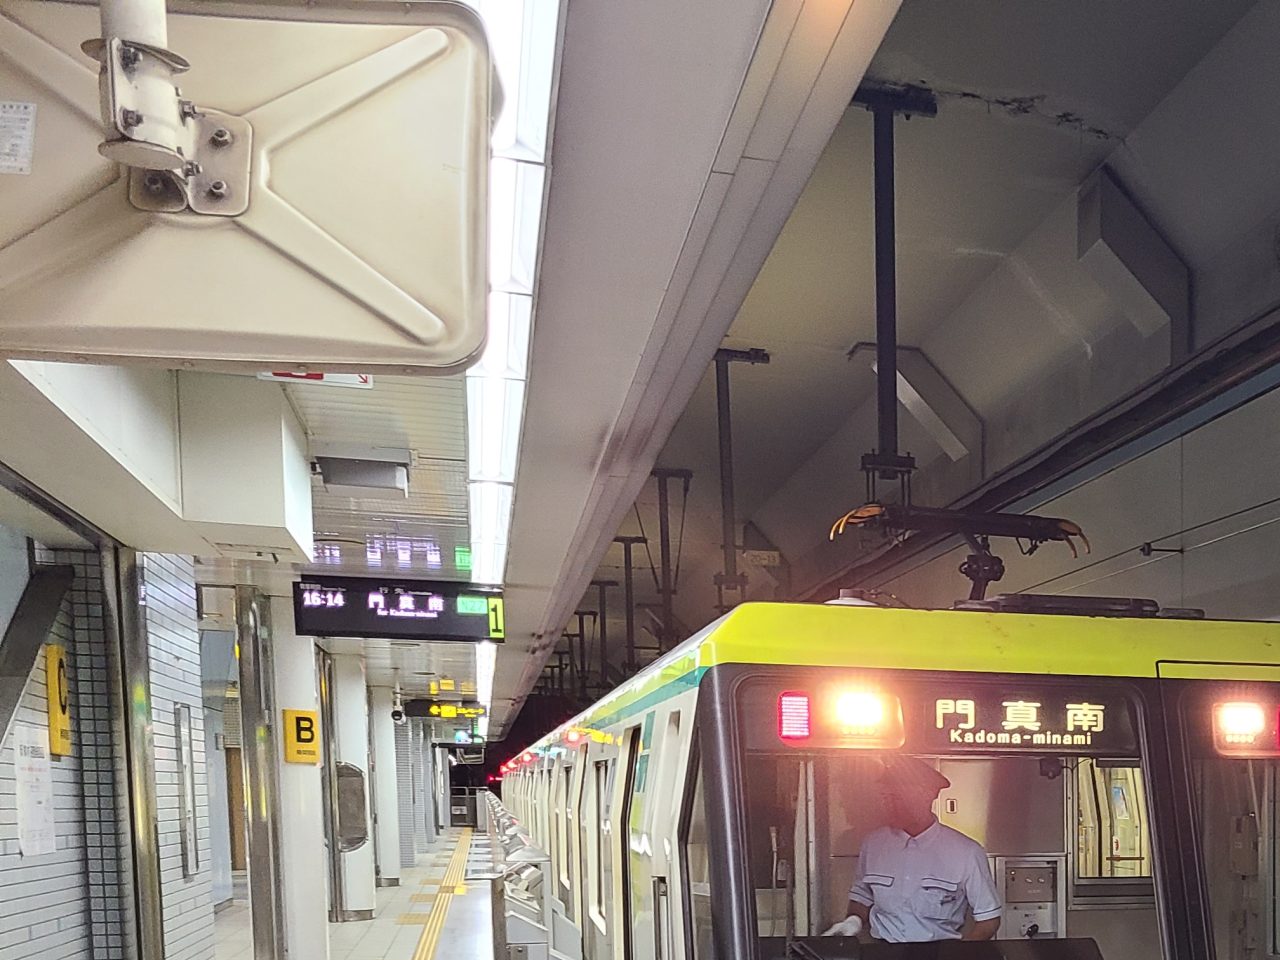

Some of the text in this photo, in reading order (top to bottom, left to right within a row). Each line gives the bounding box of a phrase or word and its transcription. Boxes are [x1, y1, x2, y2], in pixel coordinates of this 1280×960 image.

[303, 592, 345, 607] 16:14
[491, 604, 502, 633] 1
[58, 657, 68, 715] C
[295, 716, 315, 743] B
[935, 699, 1105, 732] 門真南
[950, 729, 1092, 745] Kadoma-minami
